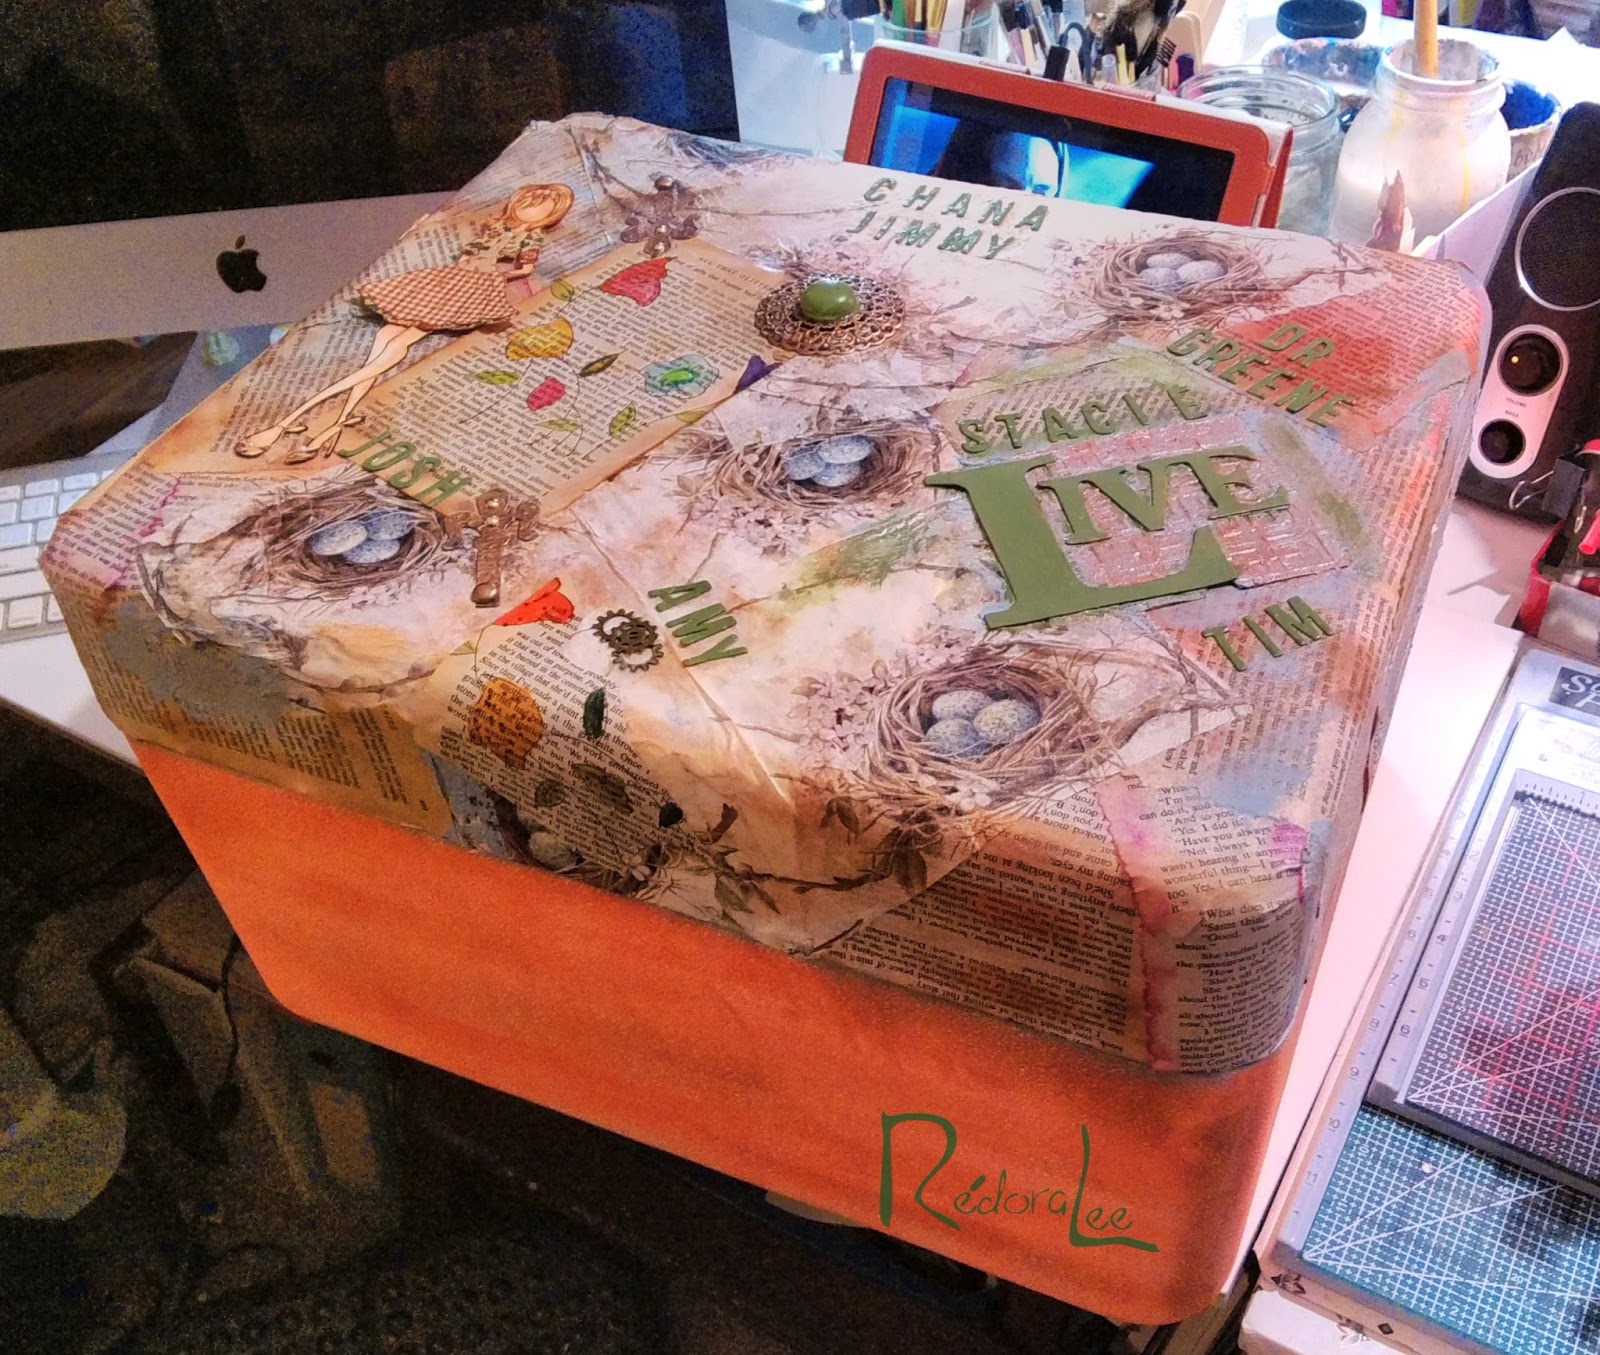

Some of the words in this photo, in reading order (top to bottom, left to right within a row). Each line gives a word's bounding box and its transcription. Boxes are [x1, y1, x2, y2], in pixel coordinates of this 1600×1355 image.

[863, 178, 1048, 231] CHANA
[846, 211, 1015, 259] JIMMY
[1263, 323, 1335, 368] DR
[1167, 329, 1355, 428] GREENE
[959, 388, 1208, 454] STACIE
[337, 431, 472, 508] JOSH
[924, 445, 1290, 630] LIVE
[648, 580, 749, 667] AMY
[1202, 595, 1334, 671] TIM
[513, 640, 529, 651] that
[529, 649, 543, 659] way
[542, 645, 554, 653] of
[551, 648, 569, 663] town
[488, 649, 497, 657] in
[497, 654, 510, 664] the
[511, 662, 533, 677] village
[533, 674, 550, 686] that
[538, 665, 547, 673] in
[548, 670, 560, 680] the
[560, 679, 590, 698] cemeter
[455, 684, 476, 699] stone
[530, 687, 551, 701] made
[556, 703, 578, 718] point
[550, 713, 559, 722] at
[562, 719, 575, 731] the
[1070, 792, 1095, 806] from
[1072, 816, 1093, 825] you
[1139, 812, 1157, 821] can
[1161, 808, 1174, 817] do
[1214, 810, 1235, 820] you
[1042, 818, 1069, 830] more
[1093, 822, 1103, 831] if
[1211, 820, 1229, 831] did
[1013, 833, 1041, 848] down
[1072, 826, 1106, 843] looked
[1213, 832, 1233, 843] you
[1236, 826, 1272, 838] always
[982, 852, 997, 863] me
[1061, 847, 1082, 858] and
[1084, 854, 1112, 867] came
[1198, 854, 1239, 867] hearing
[998, 870, 1033, 886] wanted
[1015, 860, 1053, 880] looking
[1076, 864, 1093, 876] my
[1163, 868, 1218, 885] wonderful
[1058, 874, 1081, 889] been
[1060, 887, 1105, 906] anything
[1327, 1117, 1340, 1129] 10
